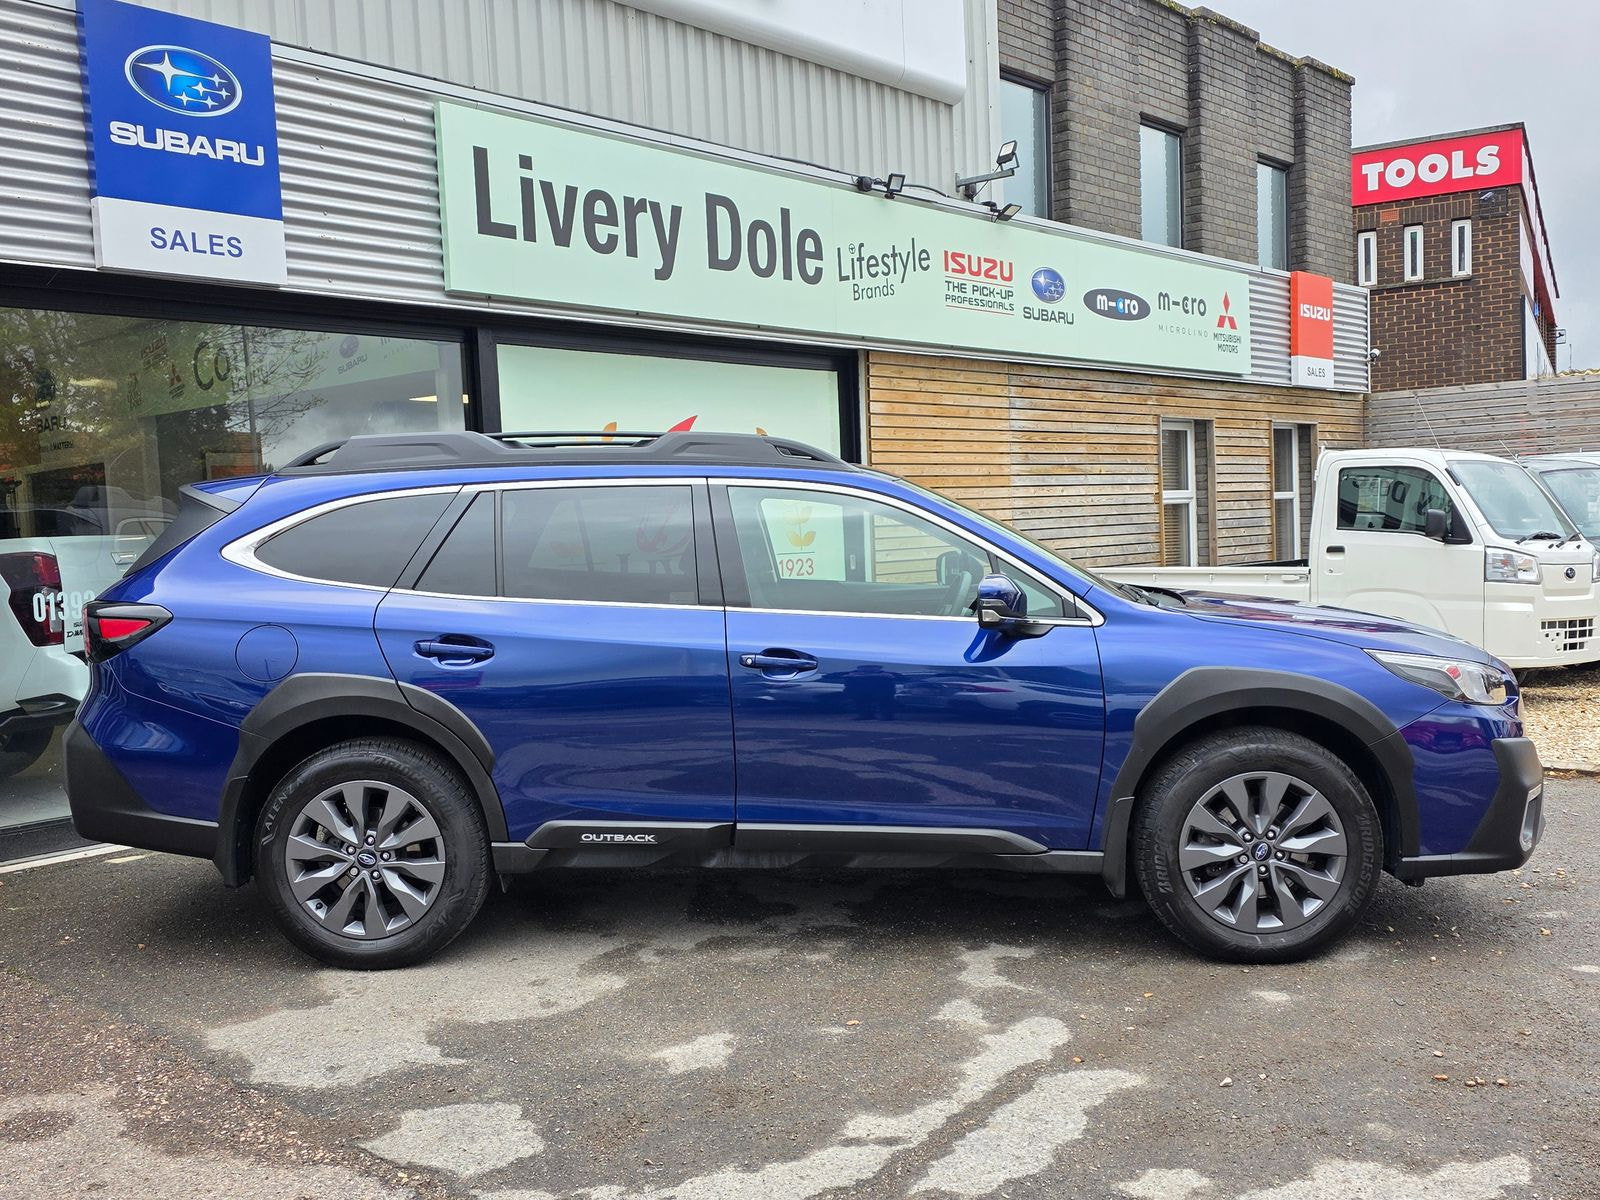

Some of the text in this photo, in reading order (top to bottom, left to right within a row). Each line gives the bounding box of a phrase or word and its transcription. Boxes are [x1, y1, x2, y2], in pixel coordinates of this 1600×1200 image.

[109, 121, 265, 167] SUBARU
[1361, 145, 1501, 191] TOOLS
[472, 145, 824, 285] Livery Dole
[150, 227, 244, 258] SALES
[837, 237, 931, 283] Lifestyle
[943, 250, 1014, 282] ISUZU
[852, 278, 895, 301] Brands
[945, 280, 1014, 301] THE PICK-UP
[945, 294, 1015, 312] PROFESSIONALS
[1300, 304, 1331, 321] ISUZU
[1022, 306, 1075, 325] SUBARU
[1213, 332, 1242, 344] MITSUBISHI
[1217, 344, 1239, 354] MOTORS
[1306, 366, 1326, 378] SALES
[778, 558, 815, 577] 1923
[580, 833, 656, 842] OUTBACK
